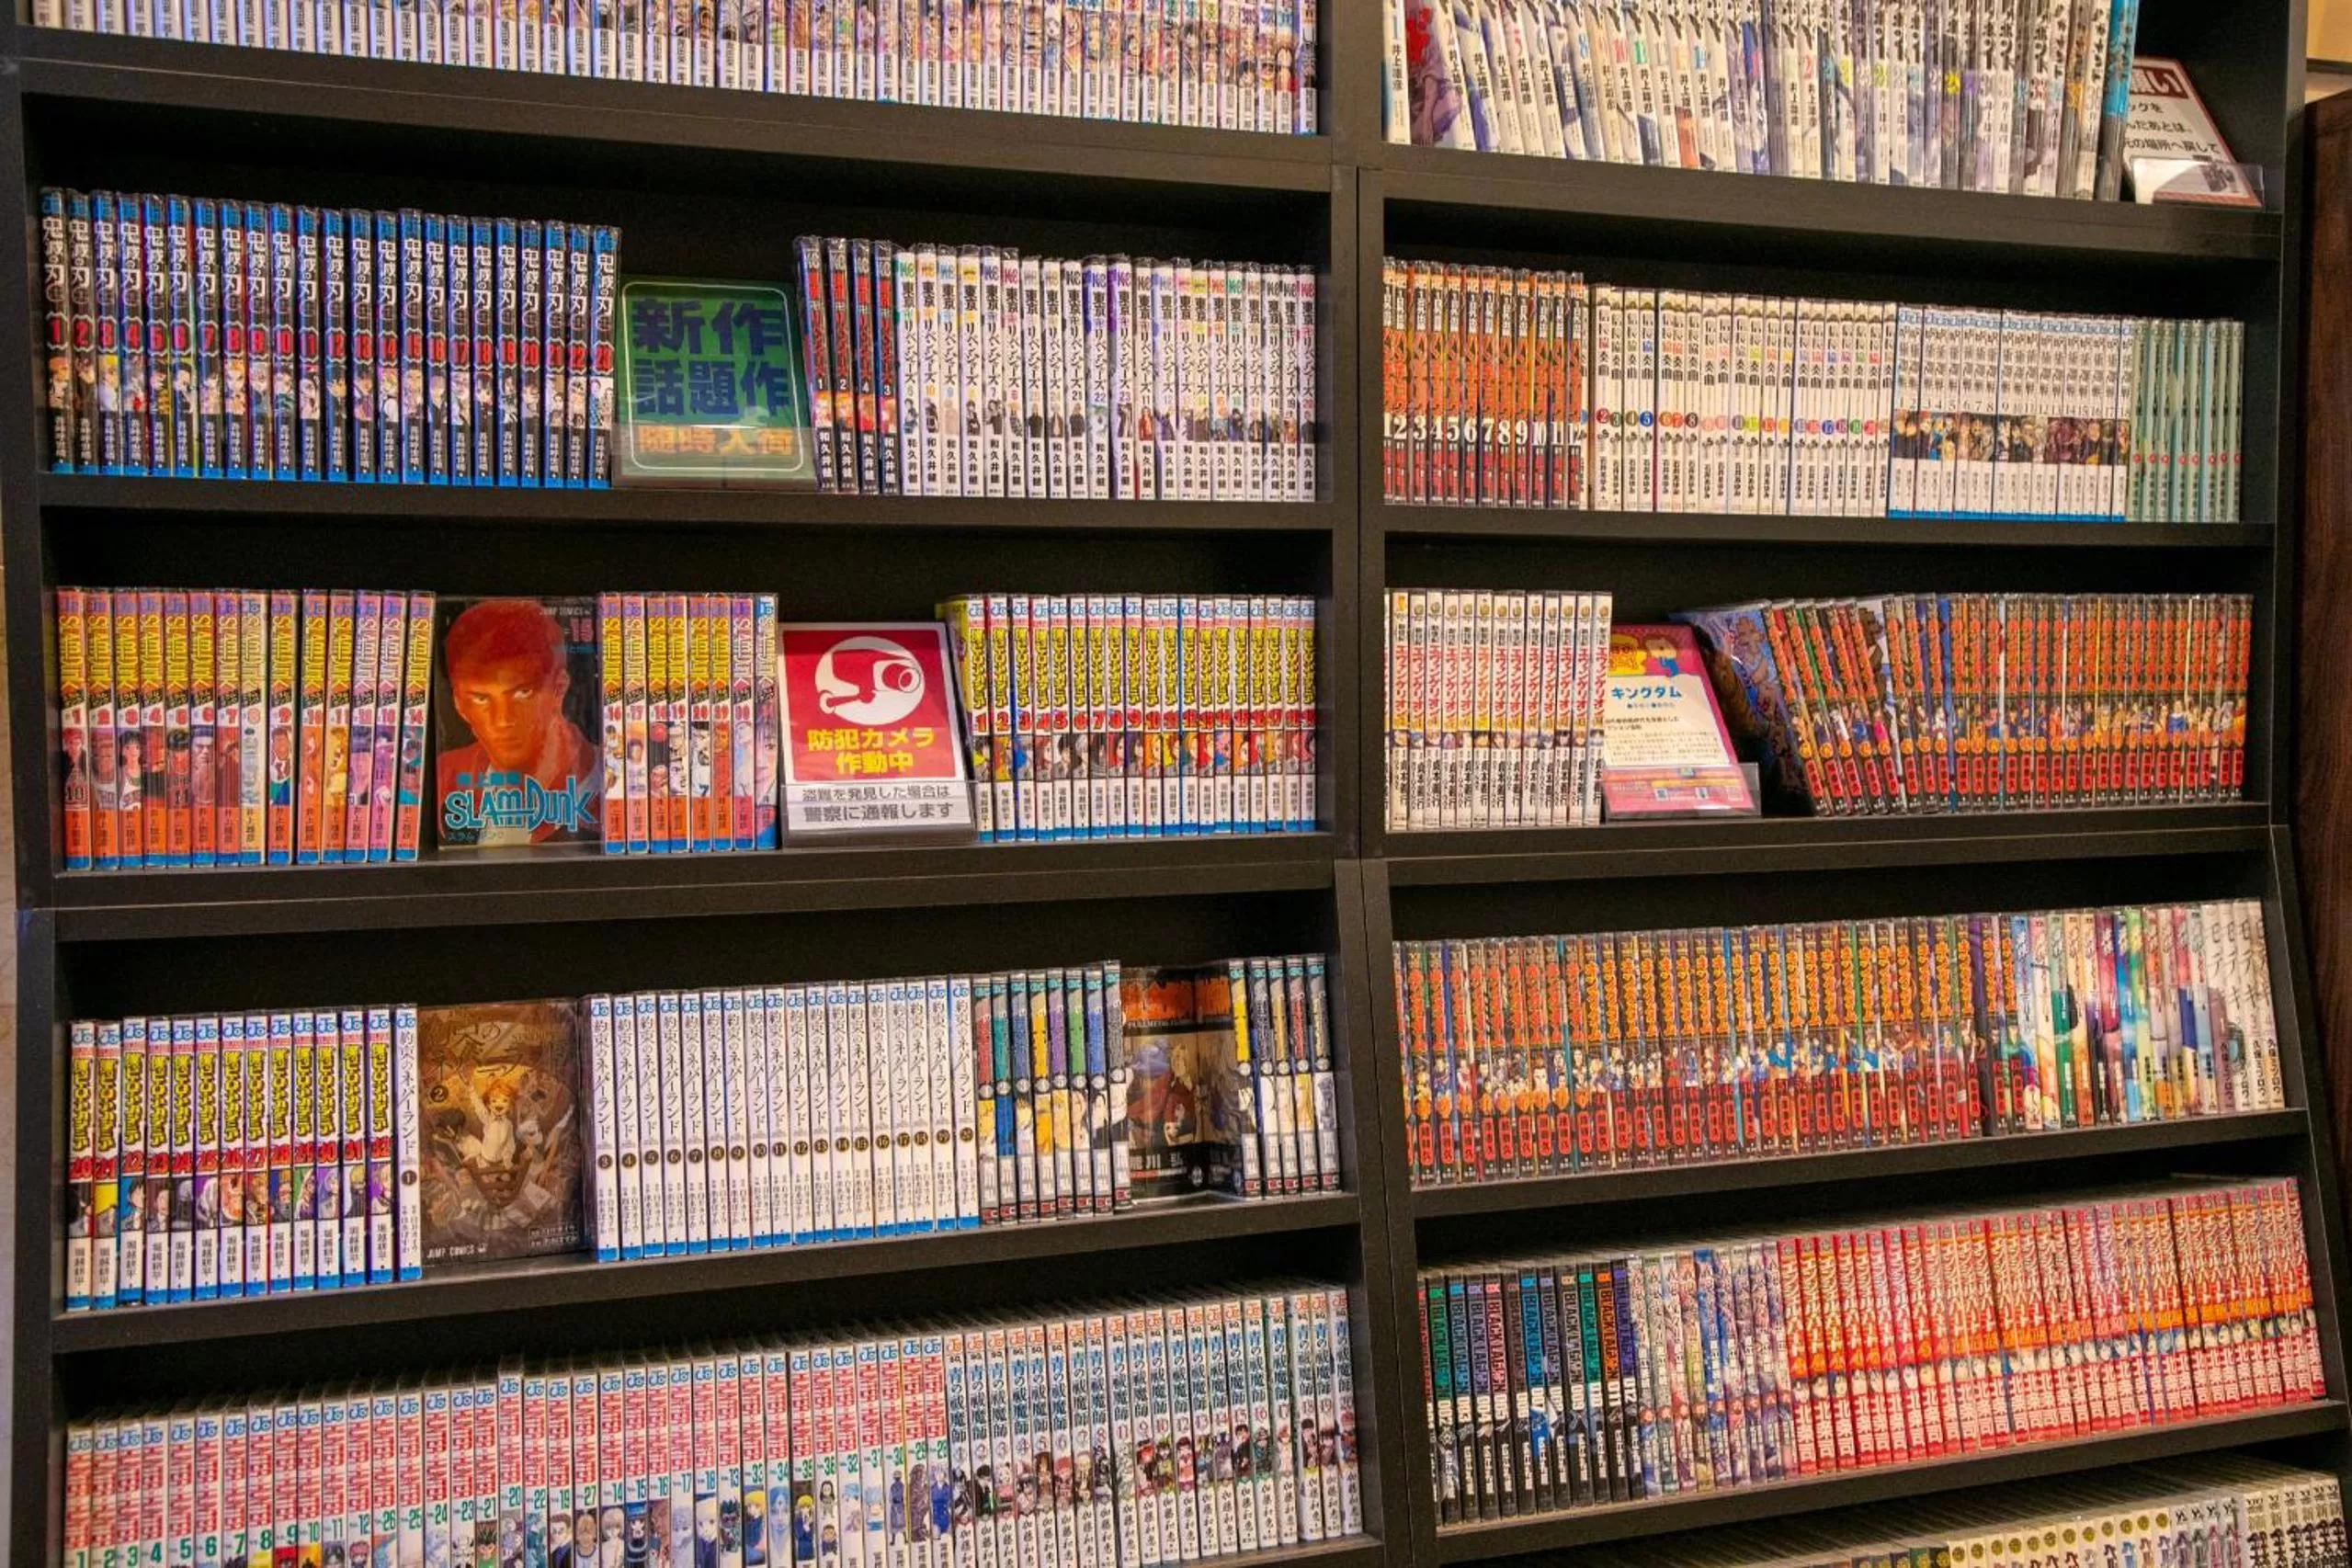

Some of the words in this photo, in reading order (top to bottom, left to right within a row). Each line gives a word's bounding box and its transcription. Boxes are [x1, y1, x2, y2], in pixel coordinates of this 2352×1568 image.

[632, 299, 784, 355] 新作
[634, 358, 791, 416] 話題作
[1094, 392, 1106, 403] 22
[1393, 415, 1407, 439] 2
[1414, 416, 1426, 440] 3
[1447, 417, 1460, 441] 5
[1464, 417, 1477, 442] 6
[1498, 420, 1511, 445] 8
[1517, 420, 1528, 445] 9
[1611, 686, 1682, 699] キングダム
[995, 711, 1009, 731] 2
[807, 727, 935, 751] 防犯カメラ
[835, 750, 914, 775] 作動中
[802, 785, 950, 802] 盗難を発見した場合は
[804, 802, 953, 823] 警察に通報します
[180, 1538, 191, 1559] 5
[206, 1536, 217, 1556] 6
[260, 1530, 271, 1550] 8
[128, 1546, 137, 1566] 3
[151, 1542, 162, 1562] 4
